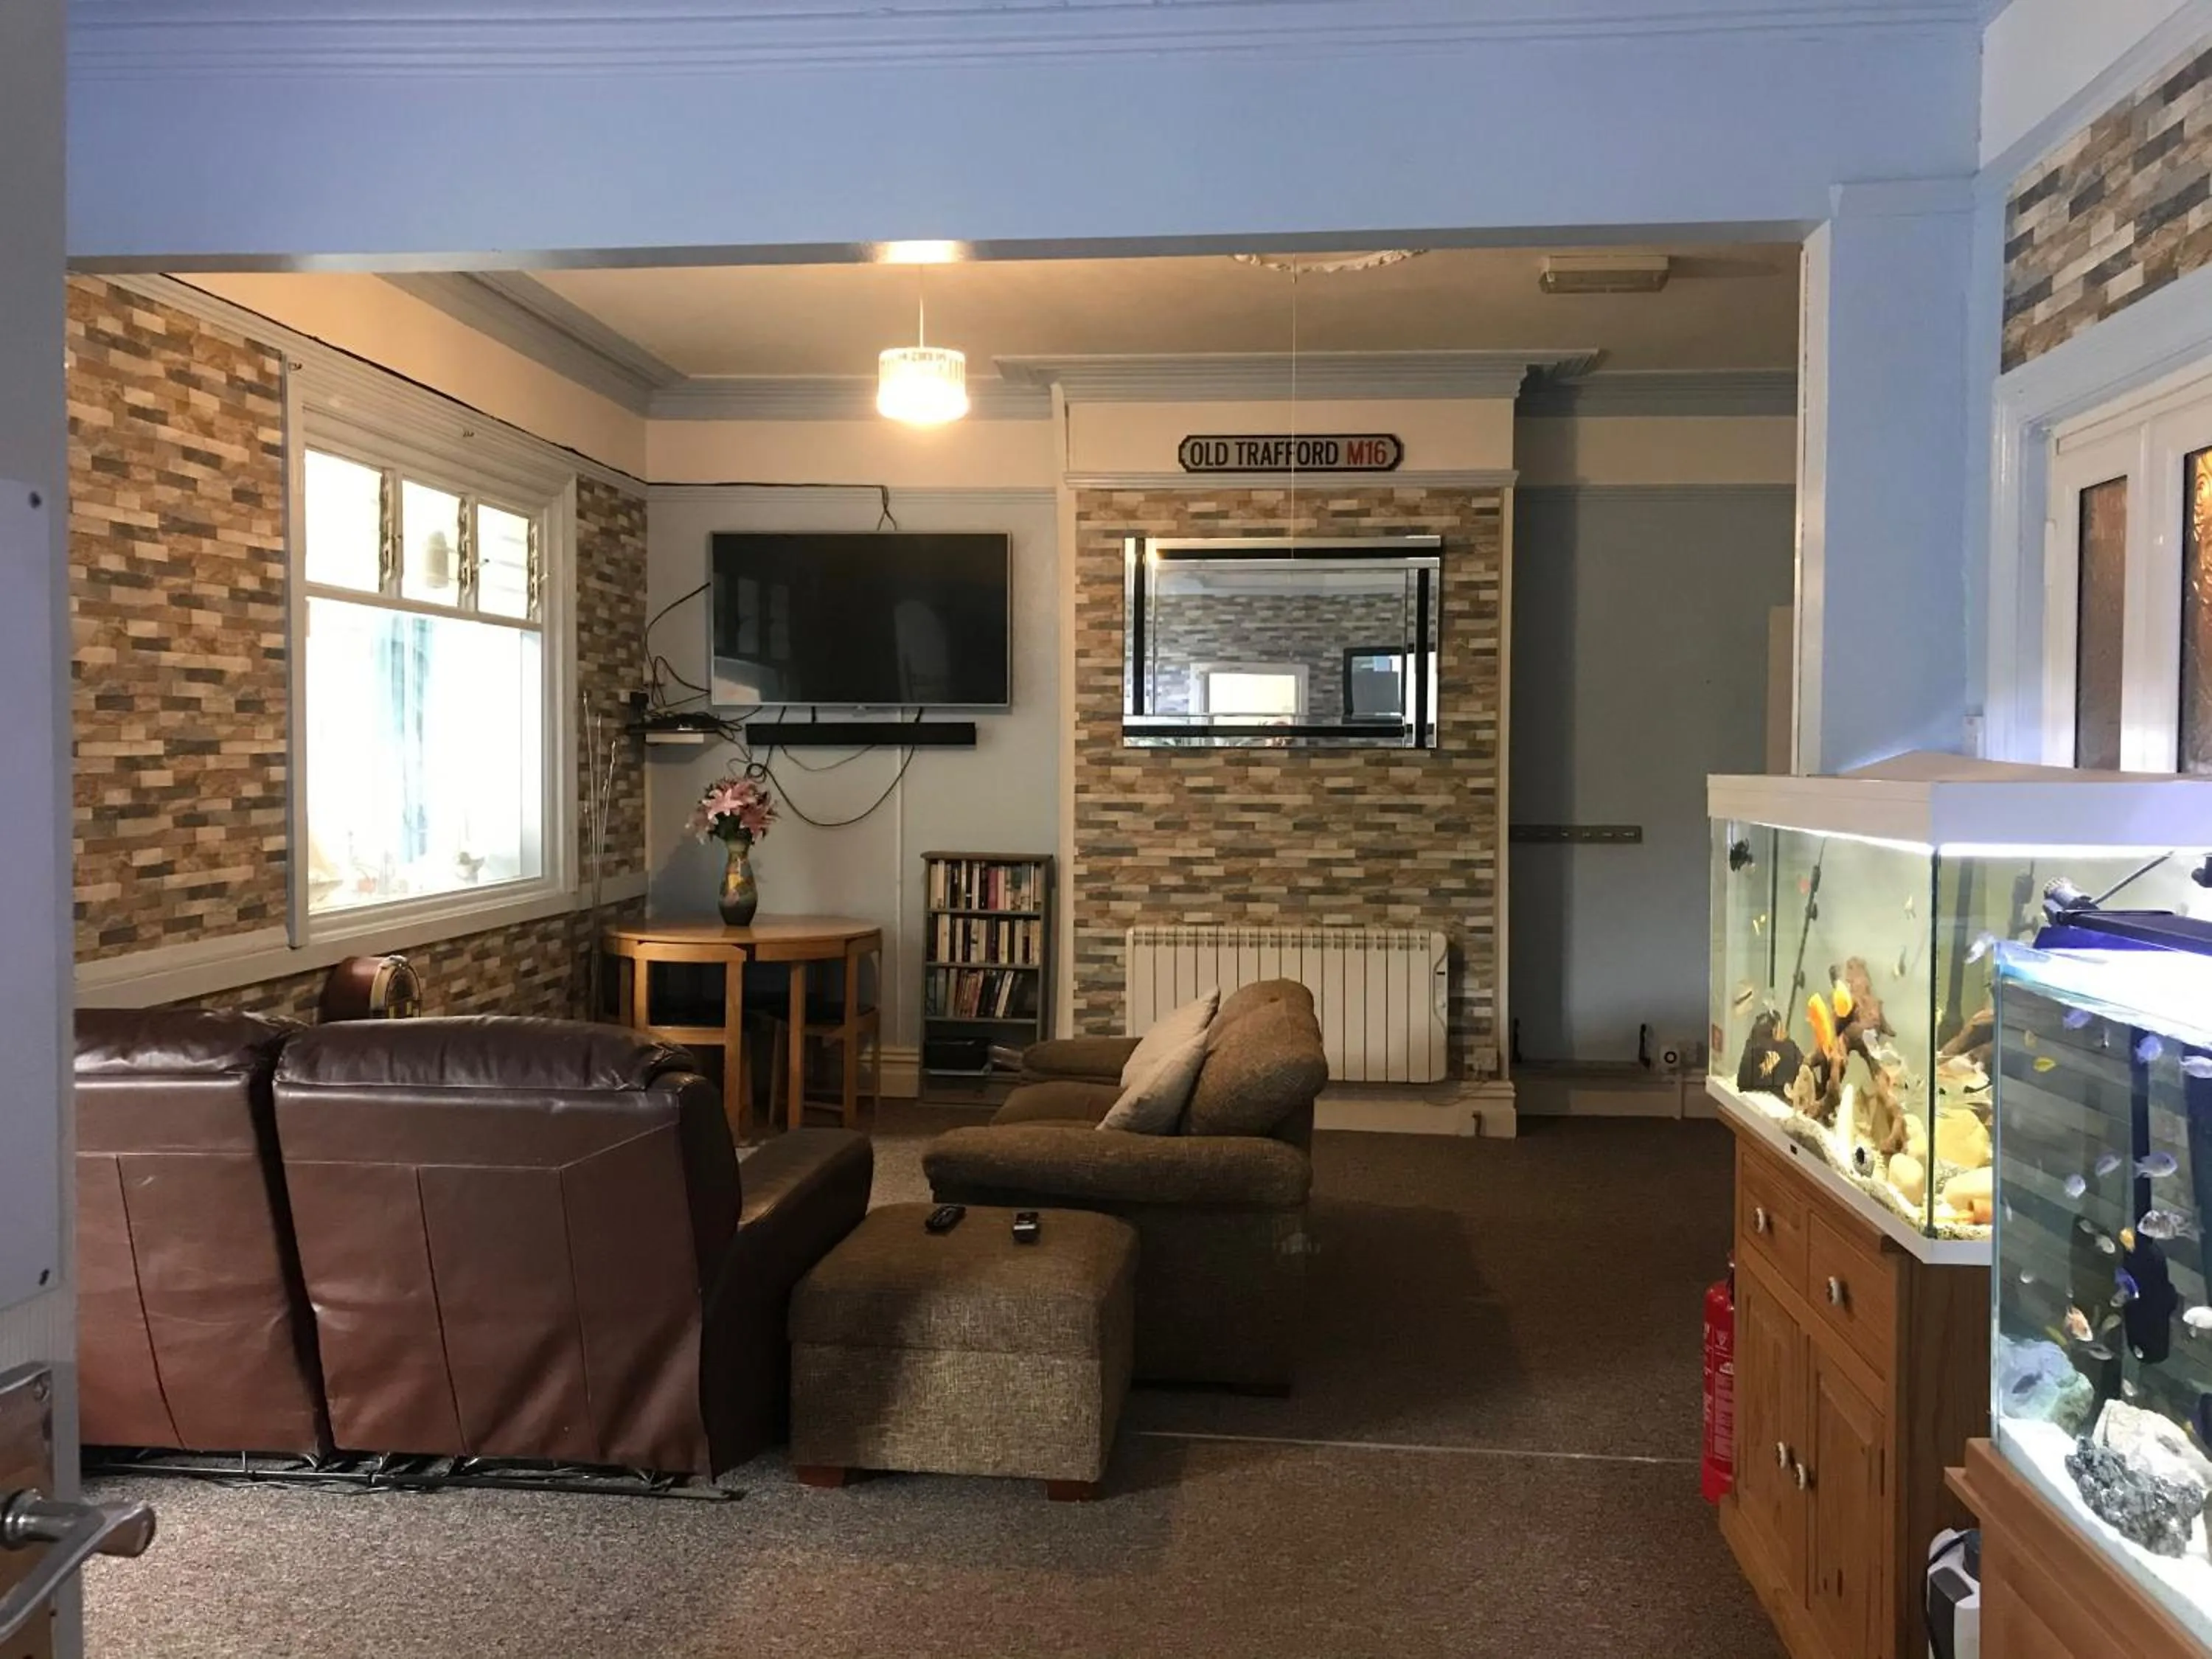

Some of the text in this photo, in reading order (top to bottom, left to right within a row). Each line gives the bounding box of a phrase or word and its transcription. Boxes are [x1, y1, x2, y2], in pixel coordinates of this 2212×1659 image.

[1189, 440, 1387, 466] OLD TRAFFORD M16
